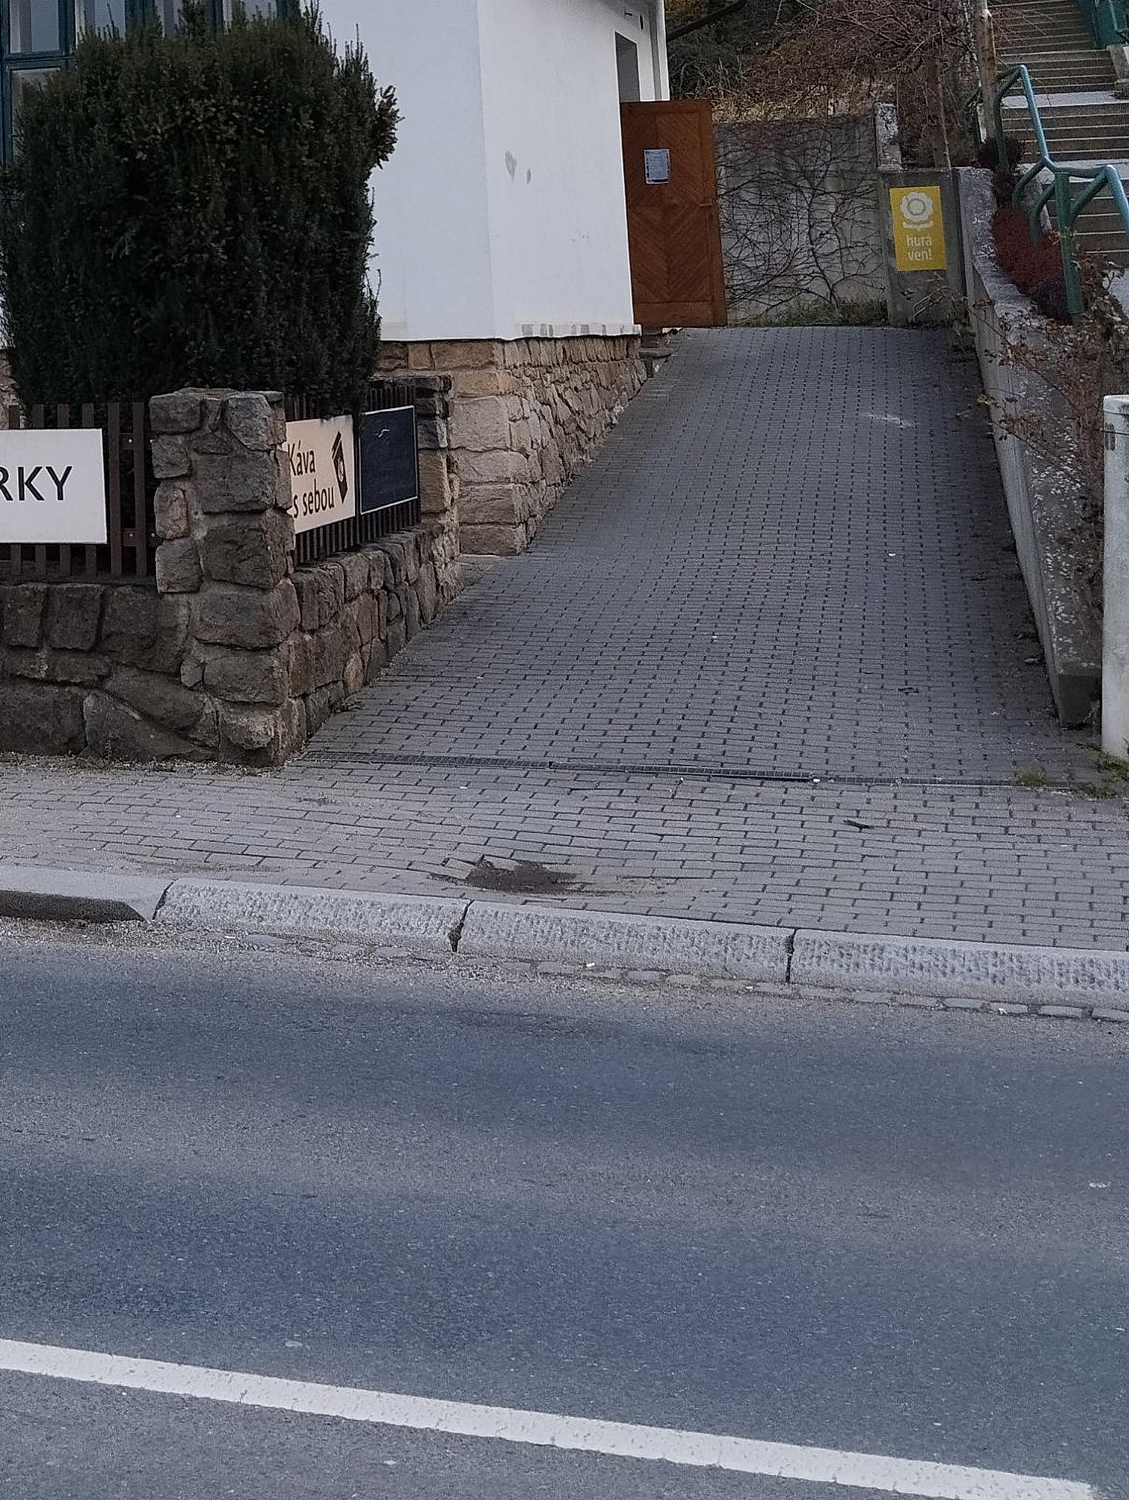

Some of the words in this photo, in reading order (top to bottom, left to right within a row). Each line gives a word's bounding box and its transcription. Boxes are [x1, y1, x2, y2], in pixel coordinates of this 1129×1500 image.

[907, 248, 932, 261] ven!
[287, 439, 316, 476] Káva
[293, 494, 299, 519] s
[303, 478, 335, 517] sebou
